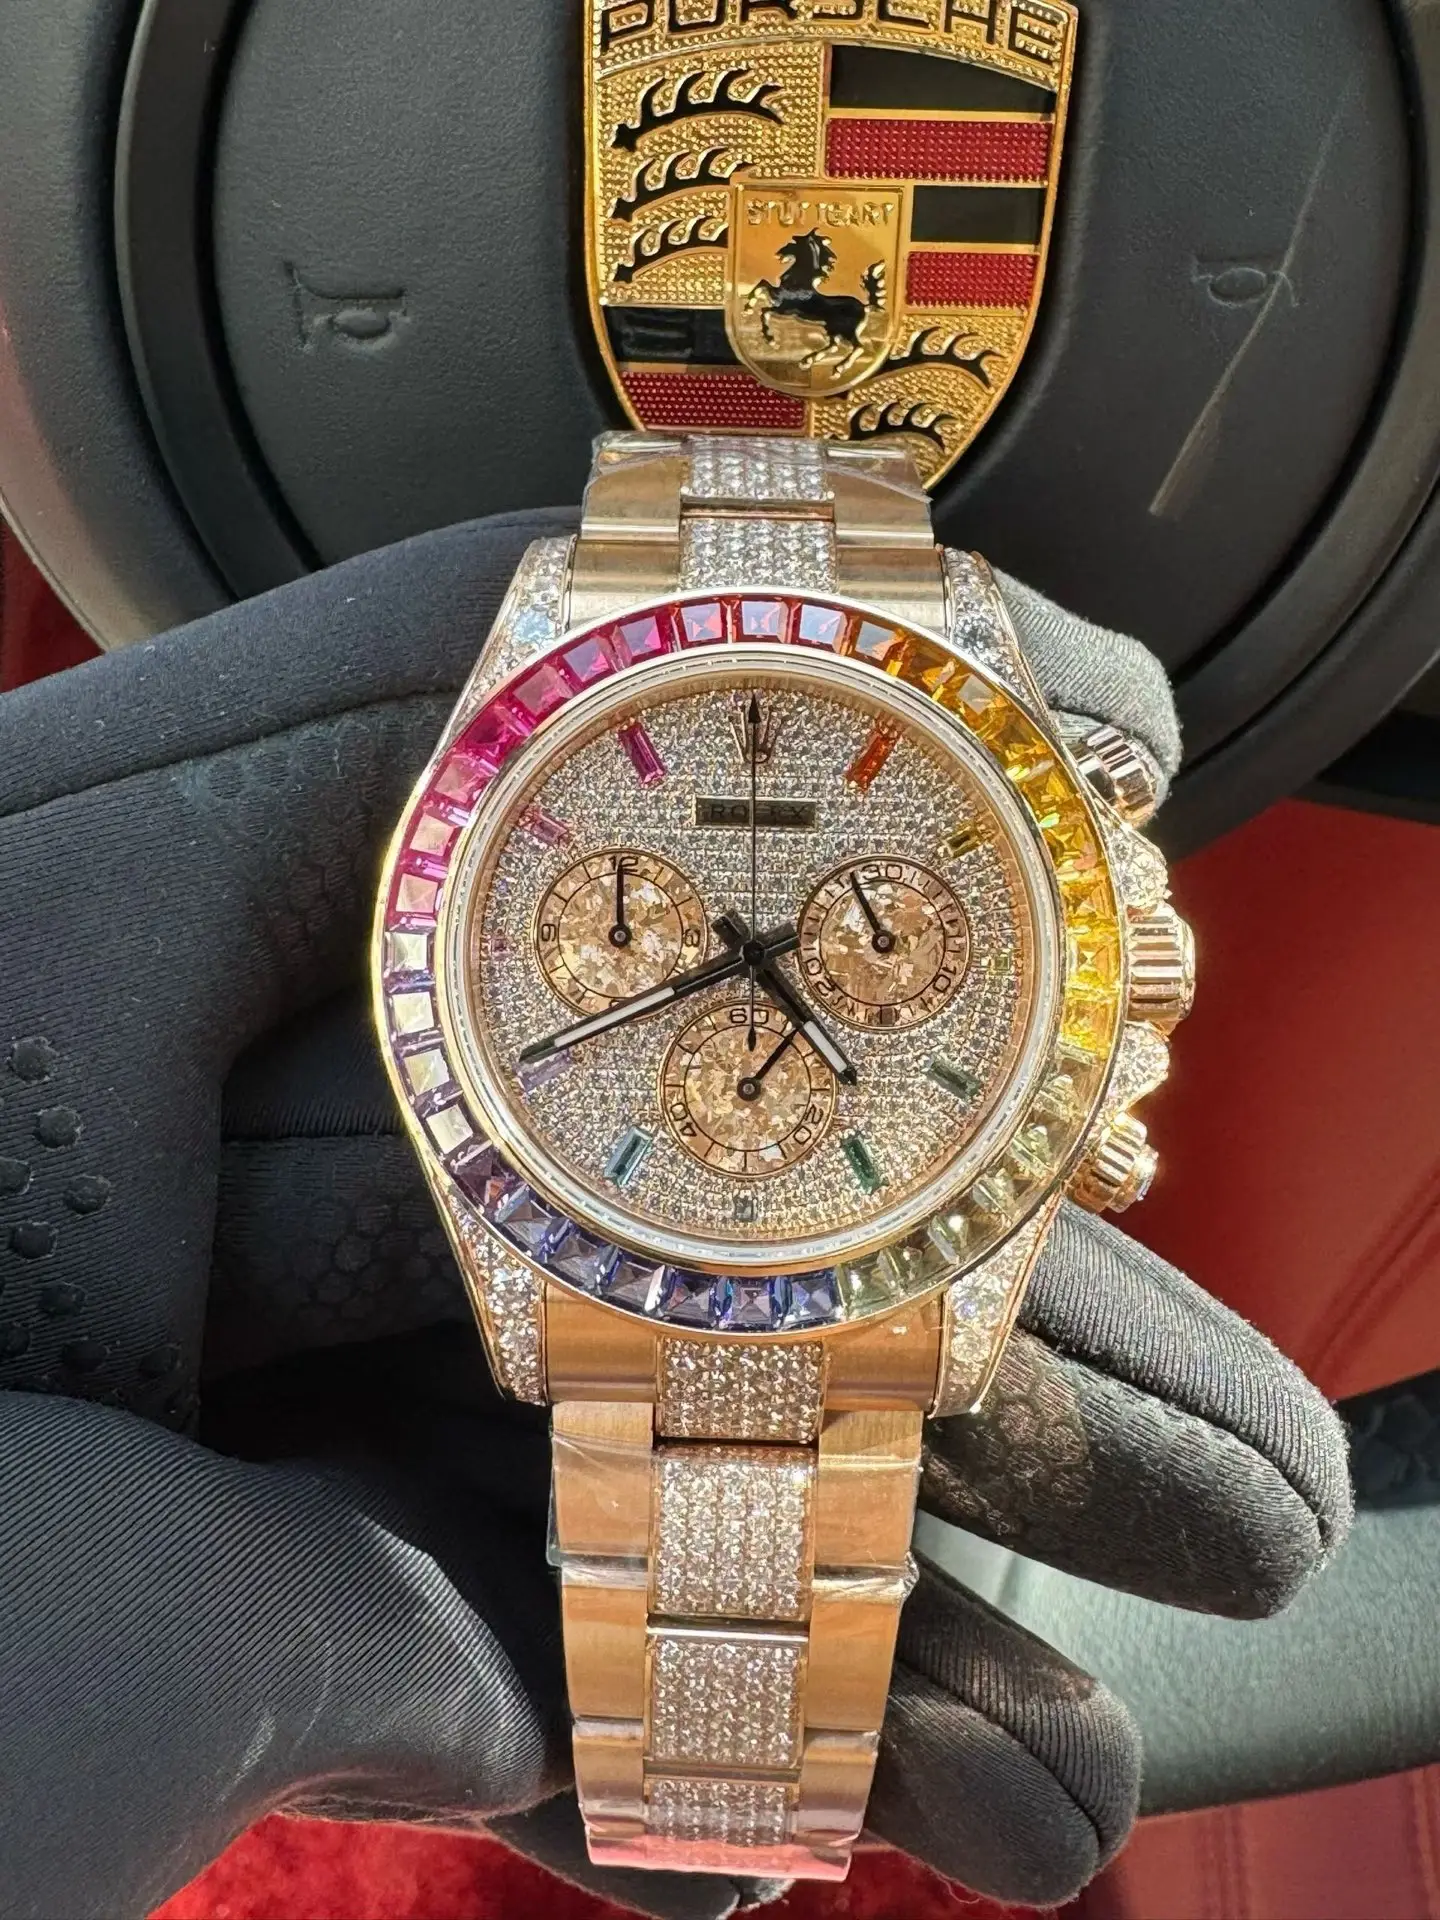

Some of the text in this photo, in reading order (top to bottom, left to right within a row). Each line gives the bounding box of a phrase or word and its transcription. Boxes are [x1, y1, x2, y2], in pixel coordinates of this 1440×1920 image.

[711, 803, 810, 822] ROEX
[608, 856, 638, 871] 12
[862, 864, 903, 881] 30
[933, 966, 957, 993] 10
[729, 1008, 770, 1024] 60
[670, 1102, 697, 1137] 40
